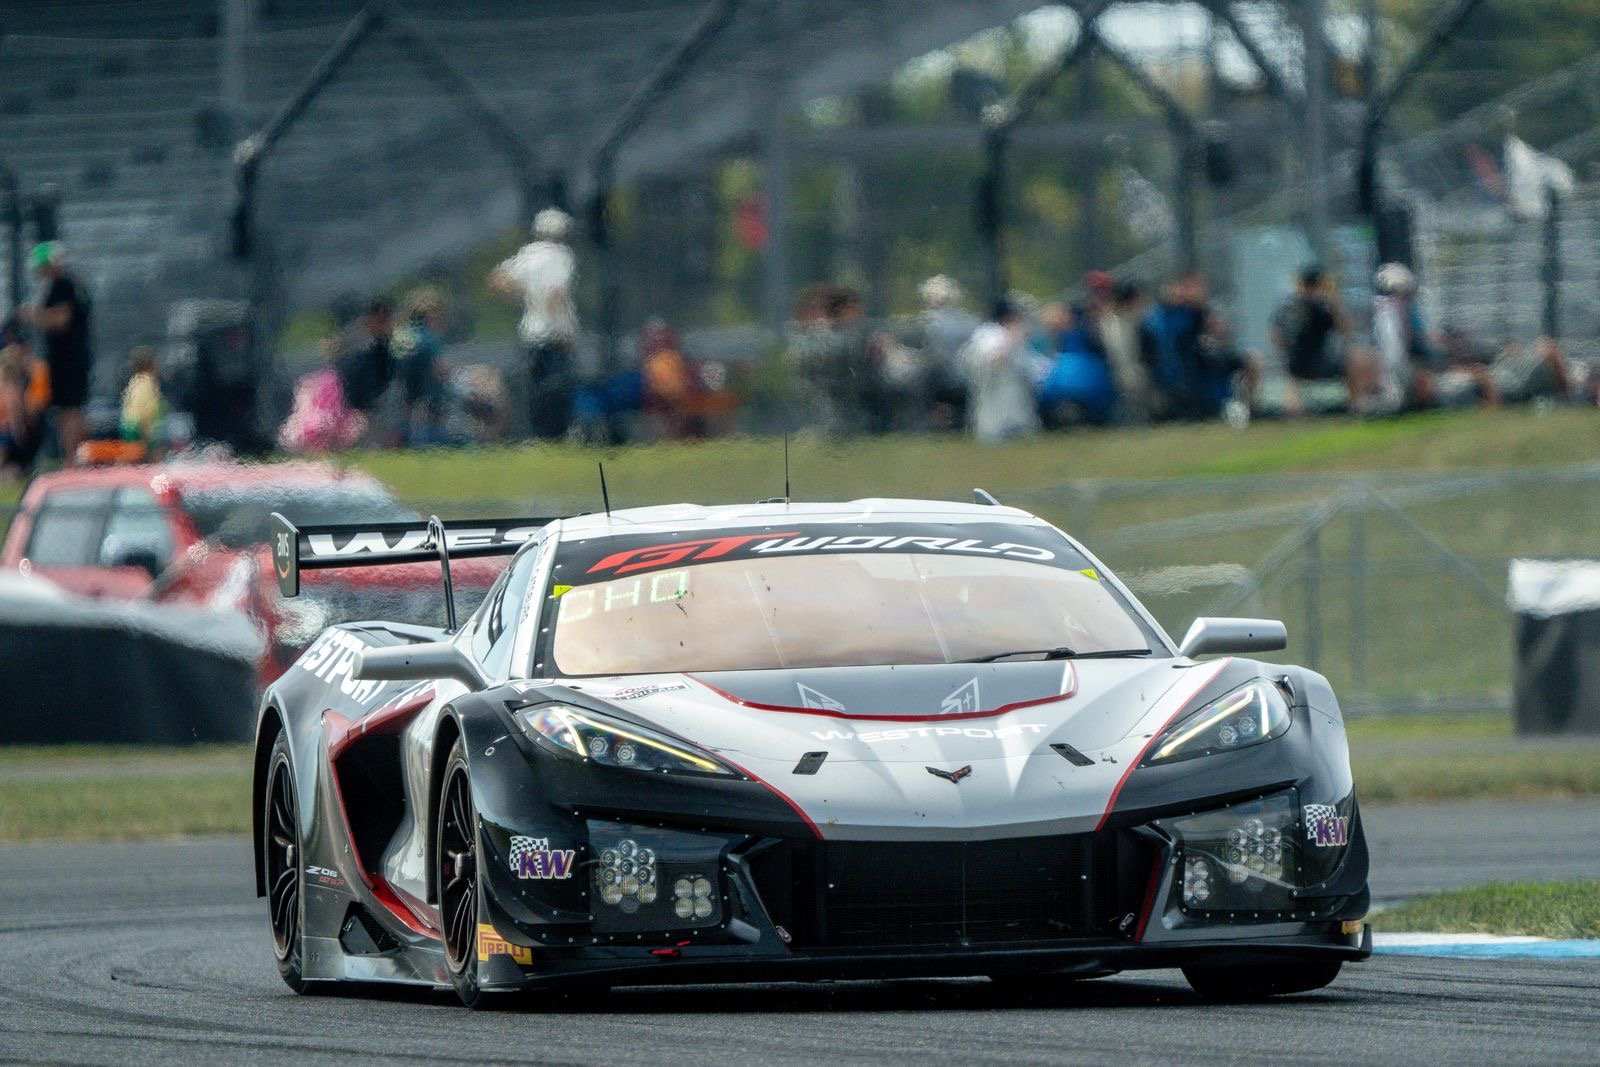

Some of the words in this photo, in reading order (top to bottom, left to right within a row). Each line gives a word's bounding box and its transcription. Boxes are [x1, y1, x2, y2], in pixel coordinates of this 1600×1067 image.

[751, 536, 1056, 560] WORLD
[811, 723, 1048, 743] WESTPORT
[1316, 816, 1348, 847] KW
[305, 865, 338, 878] Z06
[518, 849, 576, 879] KW
[479, 931, 525, 958] PIRELLI
